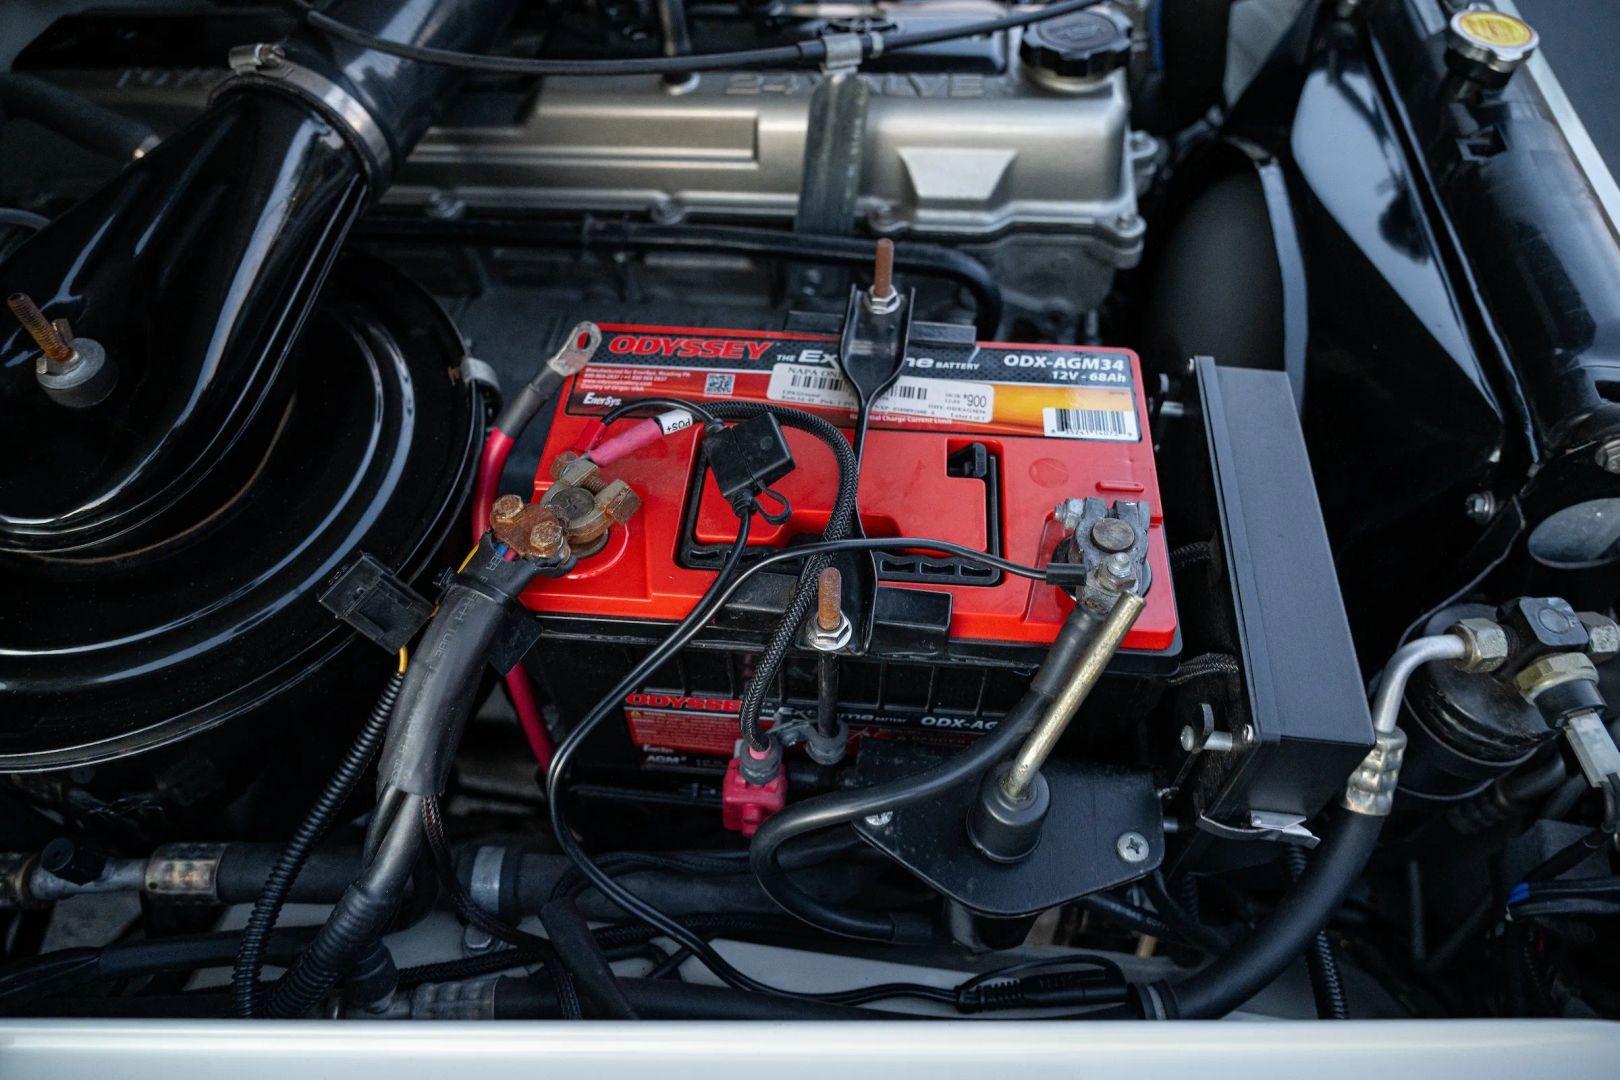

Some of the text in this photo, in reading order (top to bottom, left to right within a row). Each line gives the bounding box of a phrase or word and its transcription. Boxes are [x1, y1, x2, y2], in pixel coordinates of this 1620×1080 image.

[609, 335, 772, 360] ODYSSEY
[777, 354, 795, 363] THE
[935, 361, 980, 371] BATTERY
[1004, 354, 1124, 372] ODX-AGM34
[787, 366, 818, 376] NAPA
[1051, 370, 1079, 381] 12V
[1089, 371, 1127, 383] 68Ah
[583, 392, 621, 407] EnerSys
[882, 415, 906, 424] Charge
[907, 416, 934, 424] Current
[625, 693, 742, 713] ODYSSE
